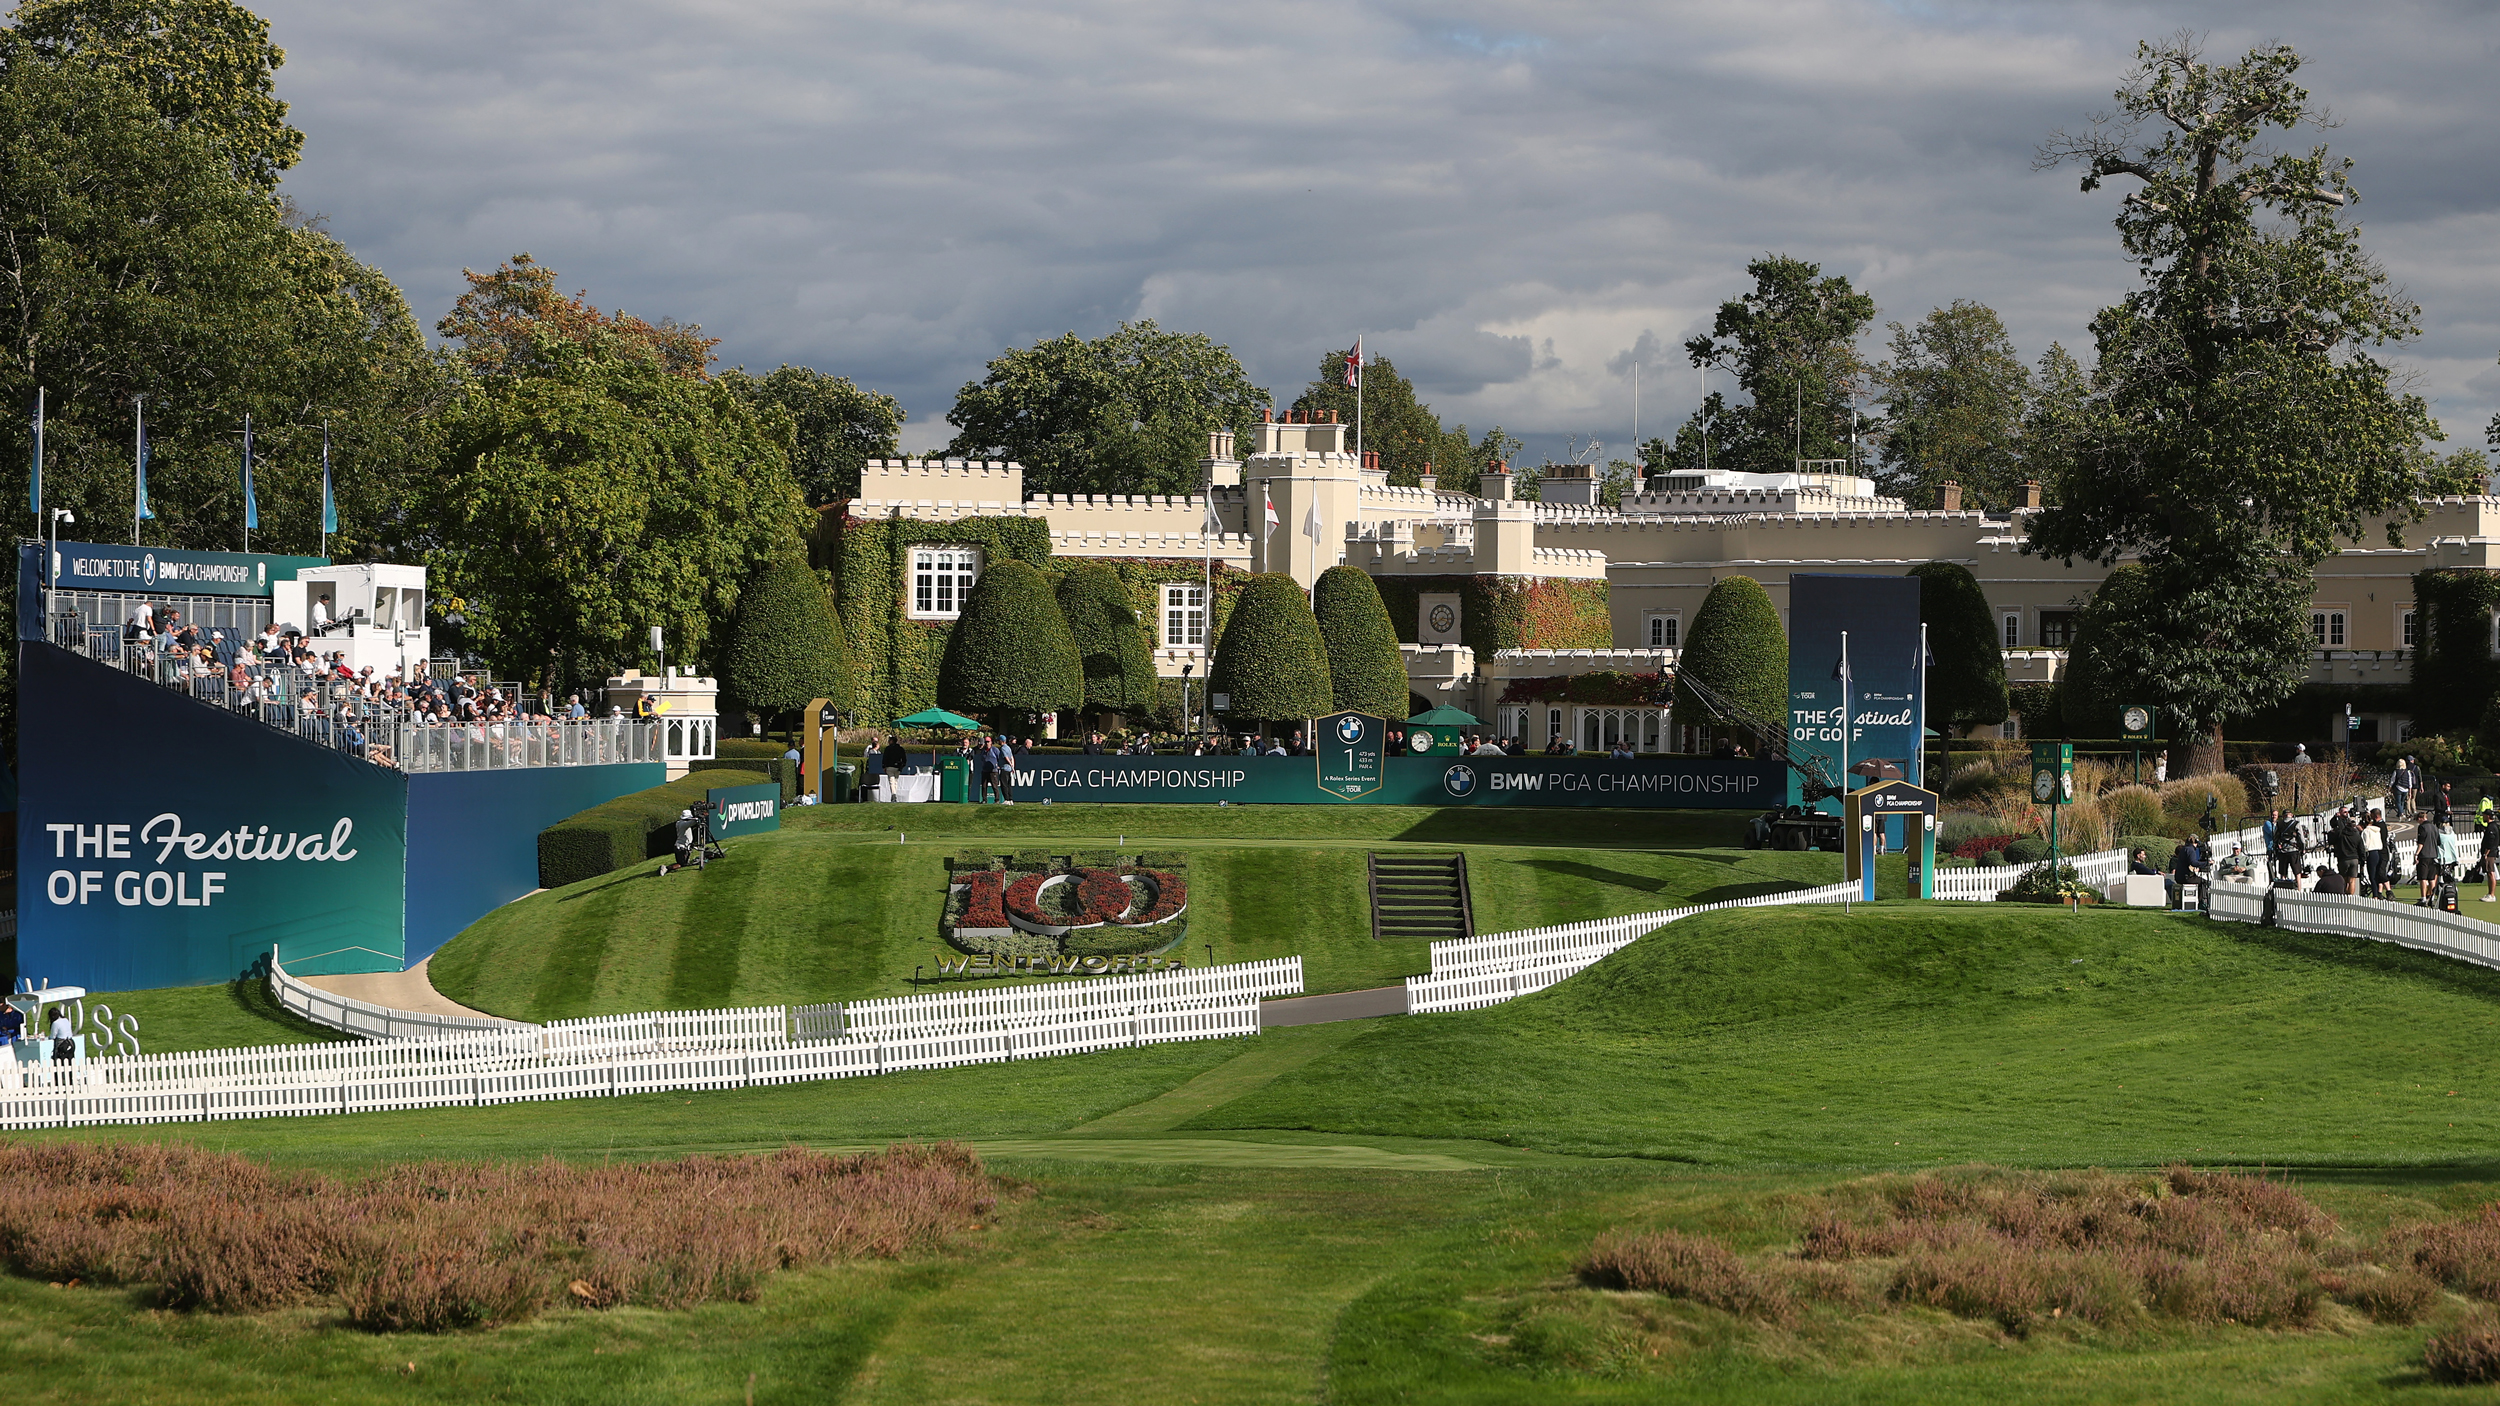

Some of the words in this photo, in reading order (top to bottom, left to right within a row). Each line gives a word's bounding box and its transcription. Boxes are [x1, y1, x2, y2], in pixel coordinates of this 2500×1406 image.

[72, 558, 112, 577] WELCOME
[112, 559, 124, 577] TO
[125, 560, 141, 578] THE
[159, 562, 179, 580] BMW
[179, 563, 197, 581] PGA
[197, 564, 249, 583] CHAMPIONSHIP
[1793, 710, 1827, 724] THE
[1829, 706, 1912, 726] Fstival
[1794, 727, 1816, 741] OF
[1820, 727, 1863, 742] GOF
[1344, 748, 1353, 772] 1
[1041, 769, 1082, 788] PGA
[1087, 769, 1245, 788] CHAMPIONSHIP
[1490, 773, 1543, 790] BMW
[1550, 773, 1591, 791] PGA
[1597, 773, 1759, 793] CHAMPIONSHIP
[728, 803, 738, 822] DP
[738, 801, 760, 820] WORLD
[760, 799, 774, 821] TOUR
[46, 823, 131, 858] THE
[140, 812, 357, 865] Festival
[47, 870, 103, 905] OF
[114, 870, 226, 906] GOLF
[950, 866, 1188, 936] 100
[934, 953, 1188, 974] WENTWORTH
